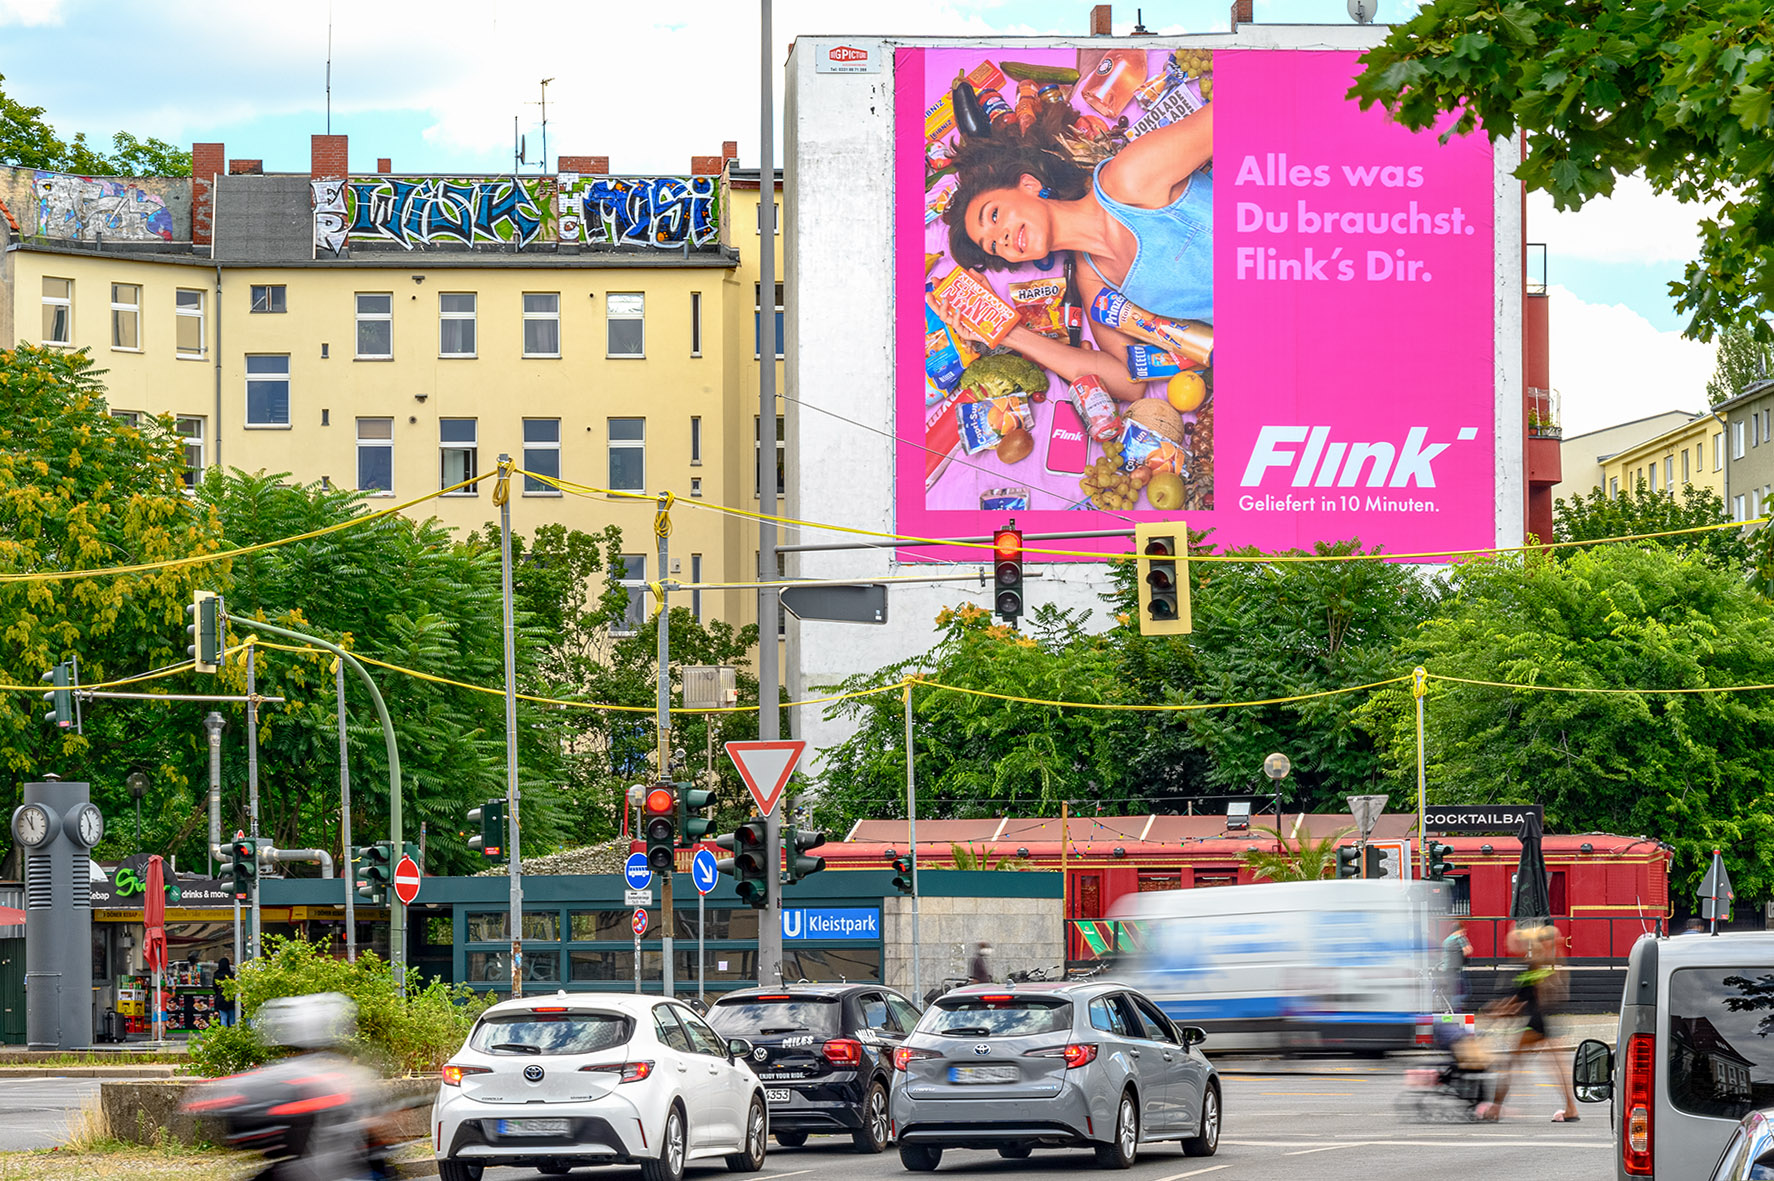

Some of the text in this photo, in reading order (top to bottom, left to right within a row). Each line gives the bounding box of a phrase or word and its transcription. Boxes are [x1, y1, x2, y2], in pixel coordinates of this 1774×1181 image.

[1133, 90, 1185, 138] JOKOLADE
[1234, 153, 1424, 188] Alles was
[1236, 200, 1475, 235] Du brauchst.
[1366, 248, 1433, 282] Dir.
[1018, 285, 1060, 300] HARIBO
[969, 403, 987, 445] Capri-Sun
[1052, 429, 1084, 441] Flink
[1240, 425, 1452, 488] Flink
[1239, 494, 1440, 512] Geliefert in 10 Minuten.
[1425, 814, 1525, 824] COCKTAILBA
[181, 890, 203, 898] drinks
[204, 890, 209, 898] &
[784, 911, 876, 937] U Kleistpark
[782, 1035, 814, 1048] MILES
[759, 1072, 774, 1080] ENJOY
